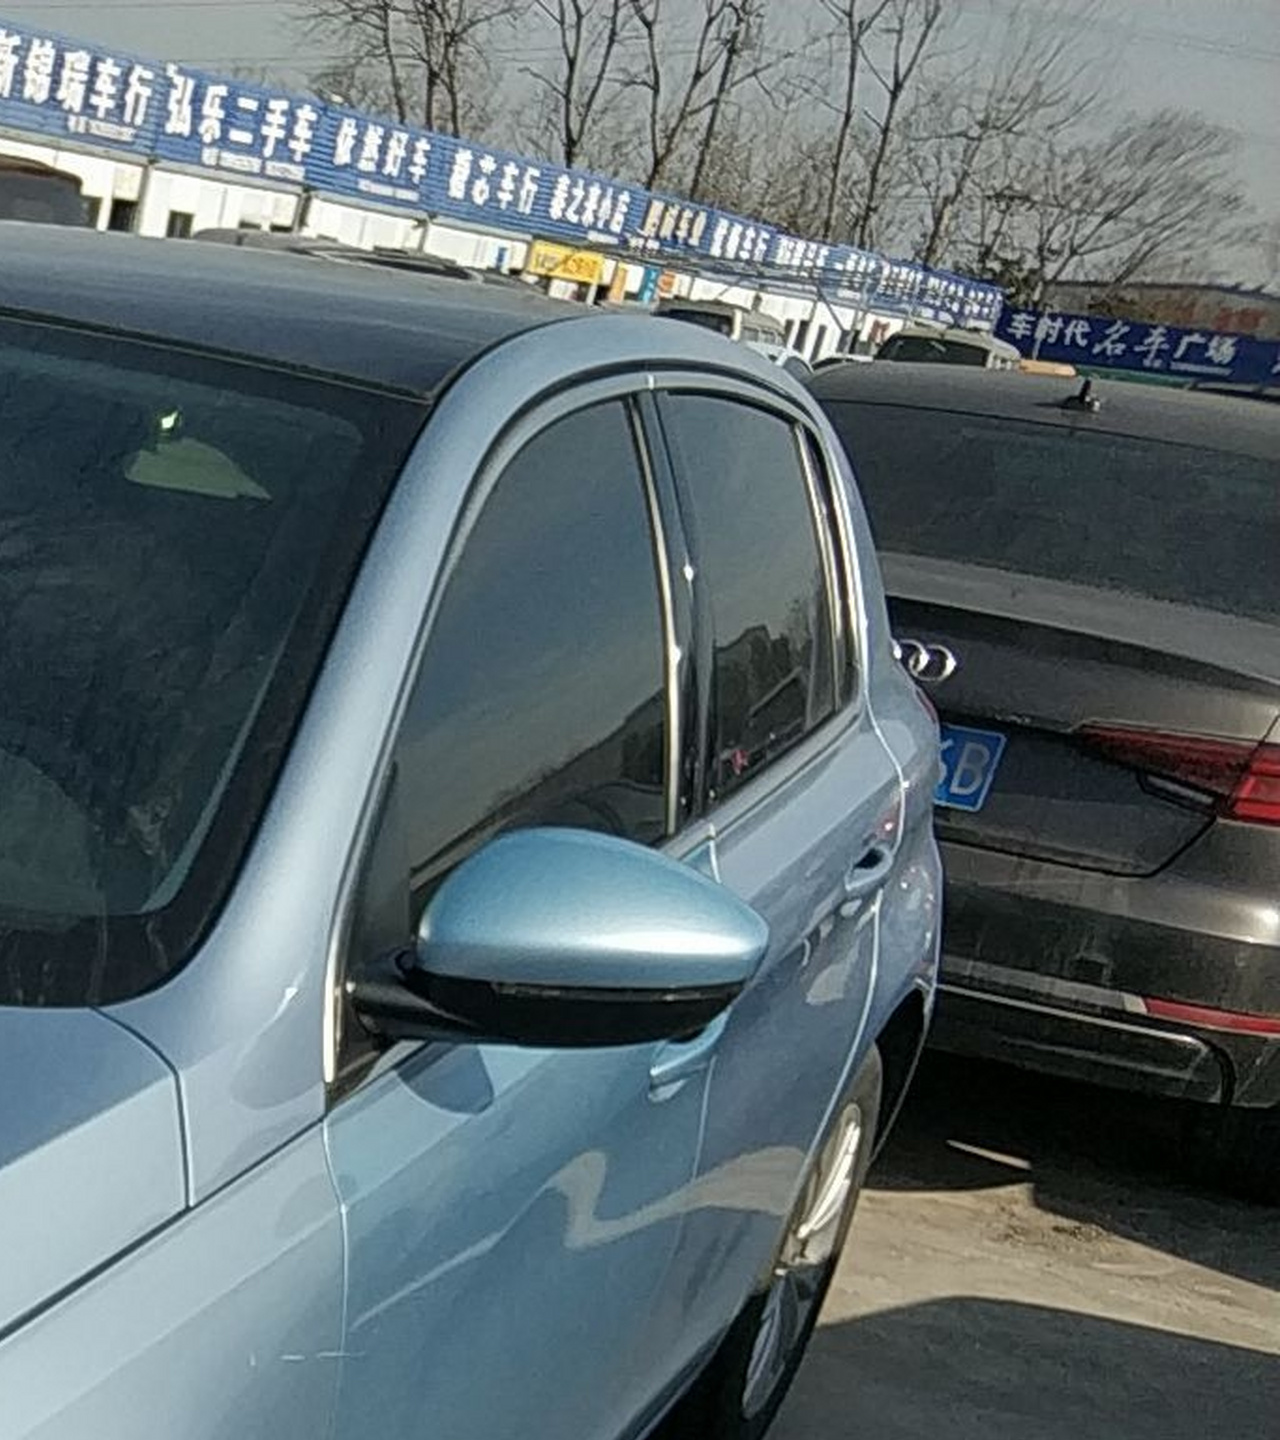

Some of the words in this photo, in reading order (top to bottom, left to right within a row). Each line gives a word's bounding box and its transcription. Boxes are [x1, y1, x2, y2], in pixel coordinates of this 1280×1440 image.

[1006, 312, 1238, 365] 车时代名车广场
